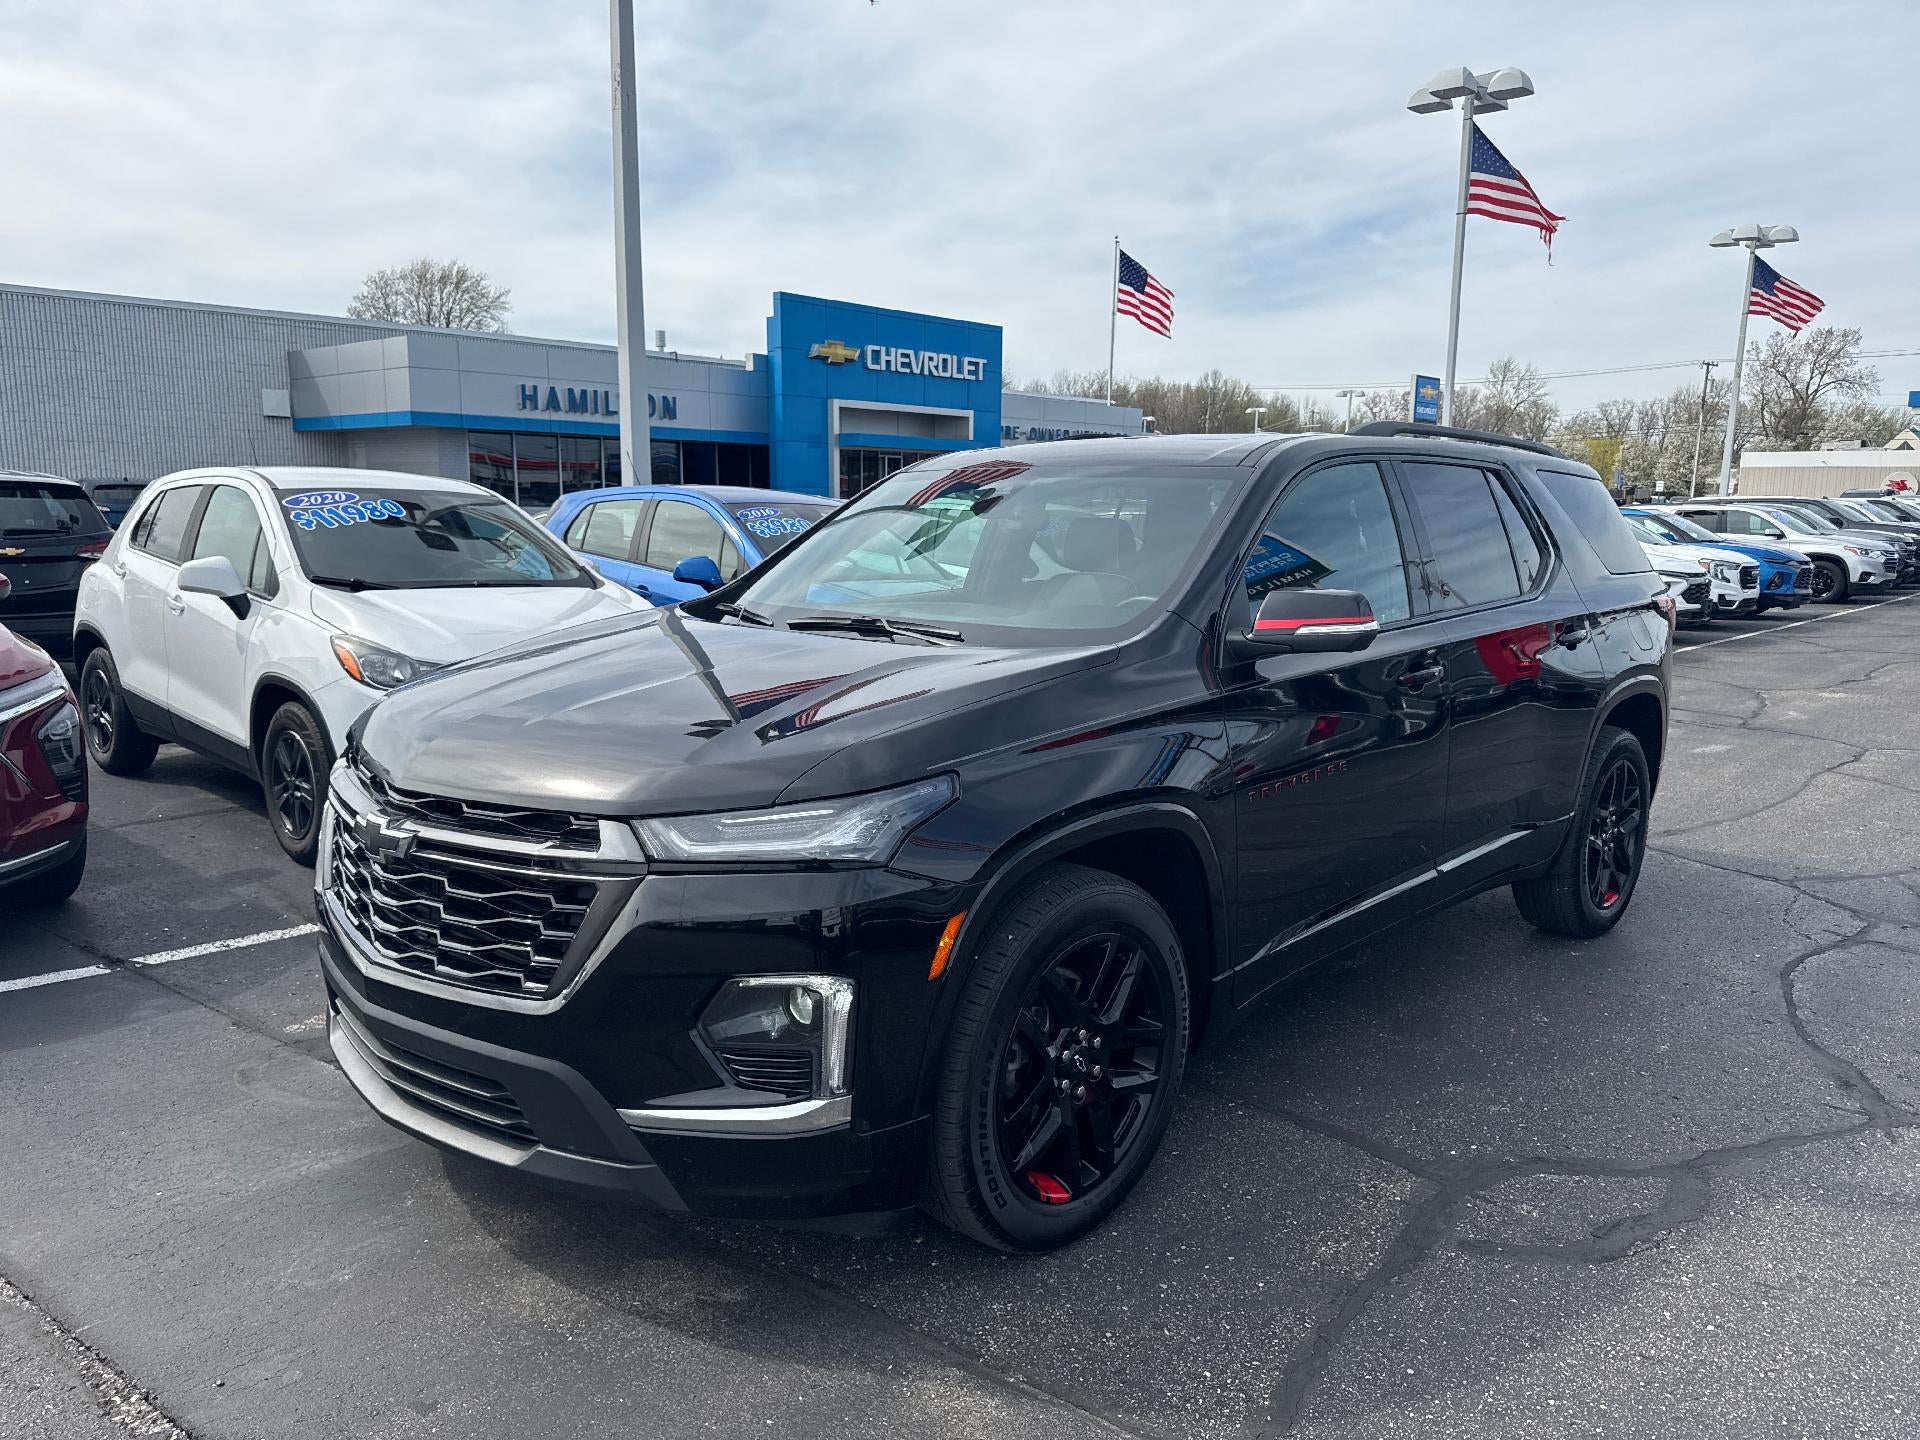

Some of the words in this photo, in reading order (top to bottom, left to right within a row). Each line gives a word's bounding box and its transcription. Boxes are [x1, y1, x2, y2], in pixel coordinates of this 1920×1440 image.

[865, 344, 987, 381] CHEVROLET
[520, 384, 677, 420] HAMILON
[290, 499, 406, 531] $11980
[299, 492, 346, 506] 2020
[744, 508, 775, 519] 2016
